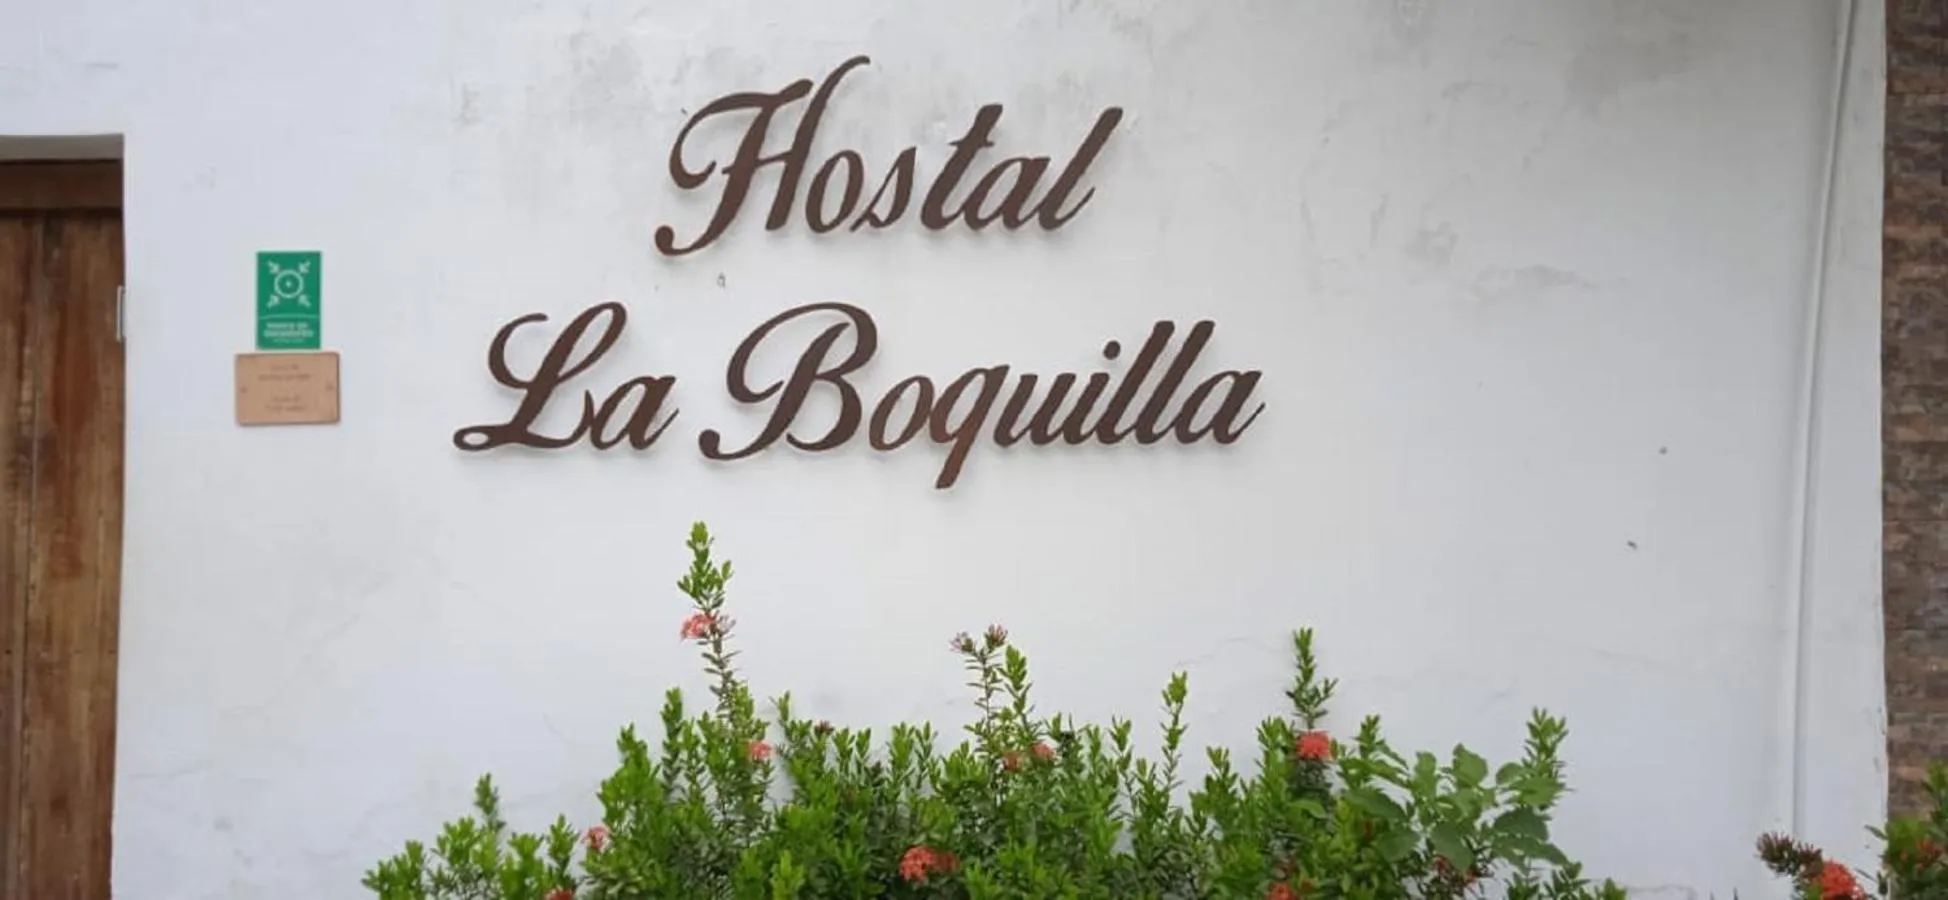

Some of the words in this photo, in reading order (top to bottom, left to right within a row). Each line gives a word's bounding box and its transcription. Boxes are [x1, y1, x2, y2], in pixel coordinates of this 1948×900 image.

[654, 55, 1124, 257] Hostal
[453, 301, 679, 452] La
[698, 302, 1266, 490] Boquilla
